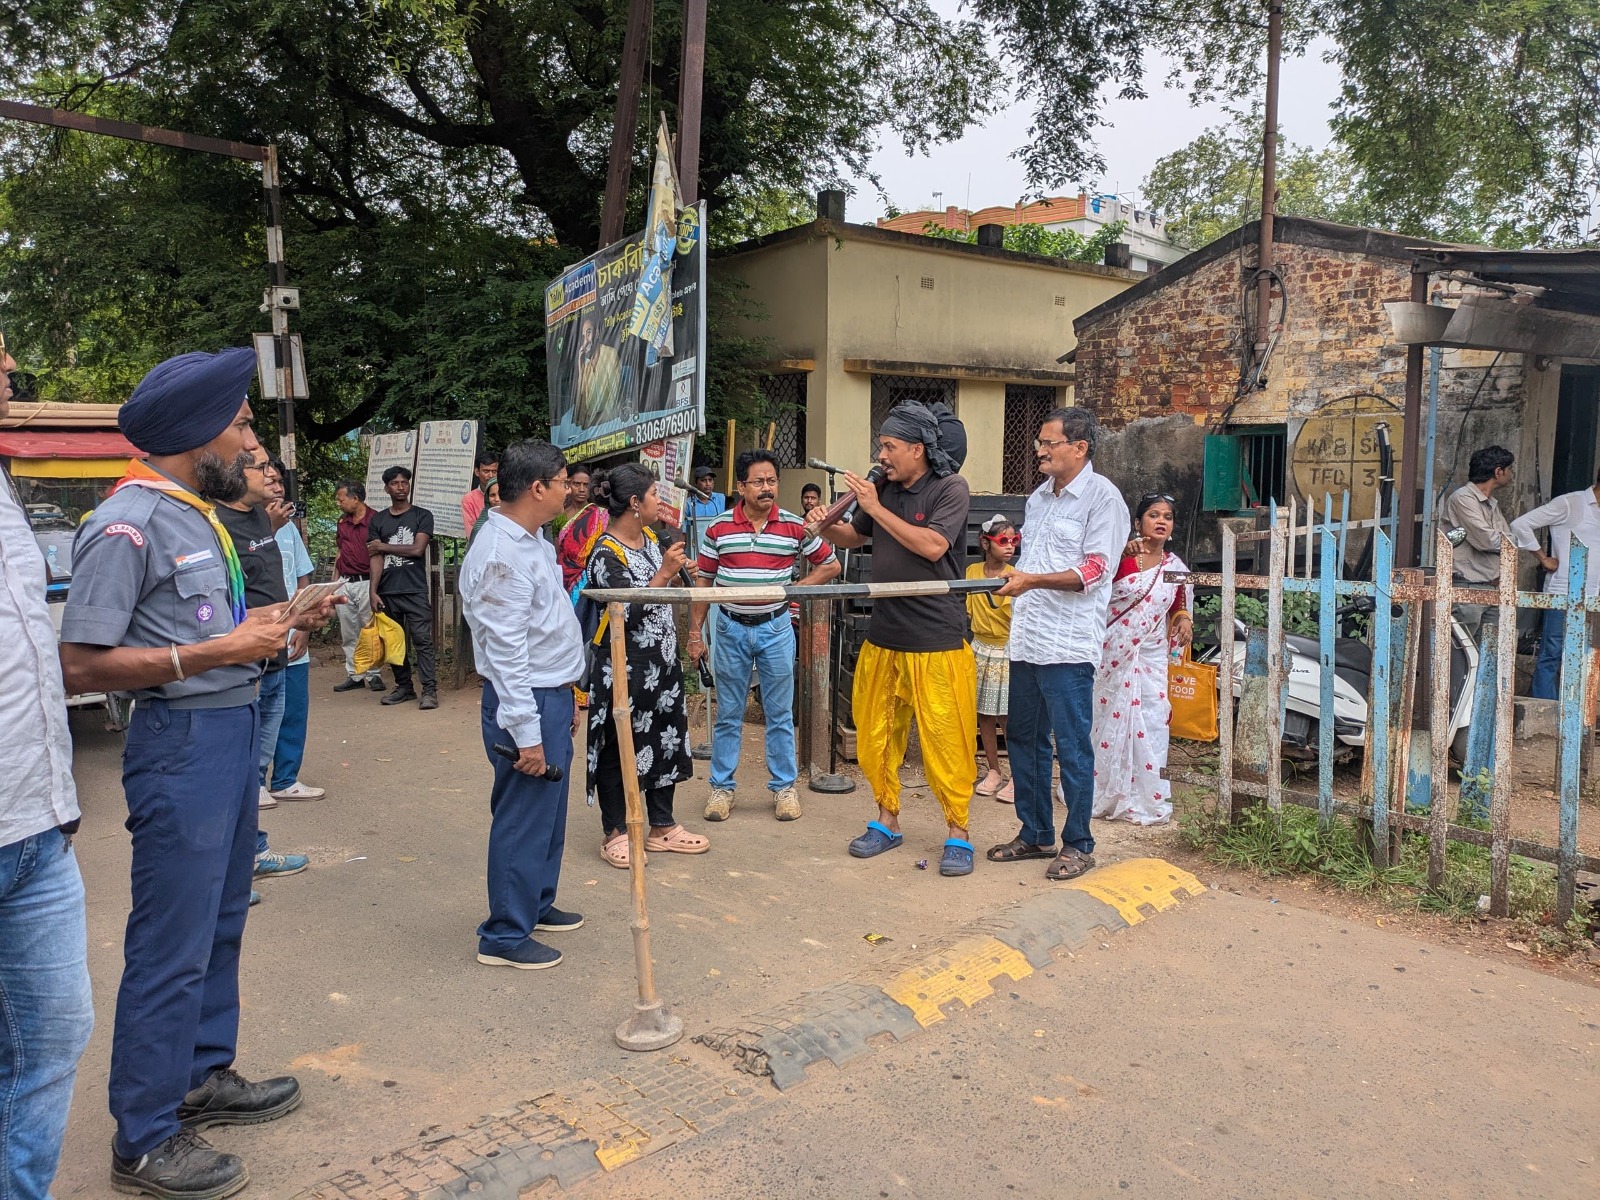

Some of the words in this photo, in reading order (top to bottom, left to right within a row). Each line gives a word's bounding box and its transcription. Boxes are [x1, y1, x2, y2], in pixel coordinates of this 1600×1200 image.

[564, 272, 595, 294] Academy
[653, 299, 666, 320] GST
[676, 396, 689, 408] BFS
[635, 408, 697, 445] 8306976900
[1362, 467, 1377, 487] 3
[1170, 684, 1195, 695] FOOD
